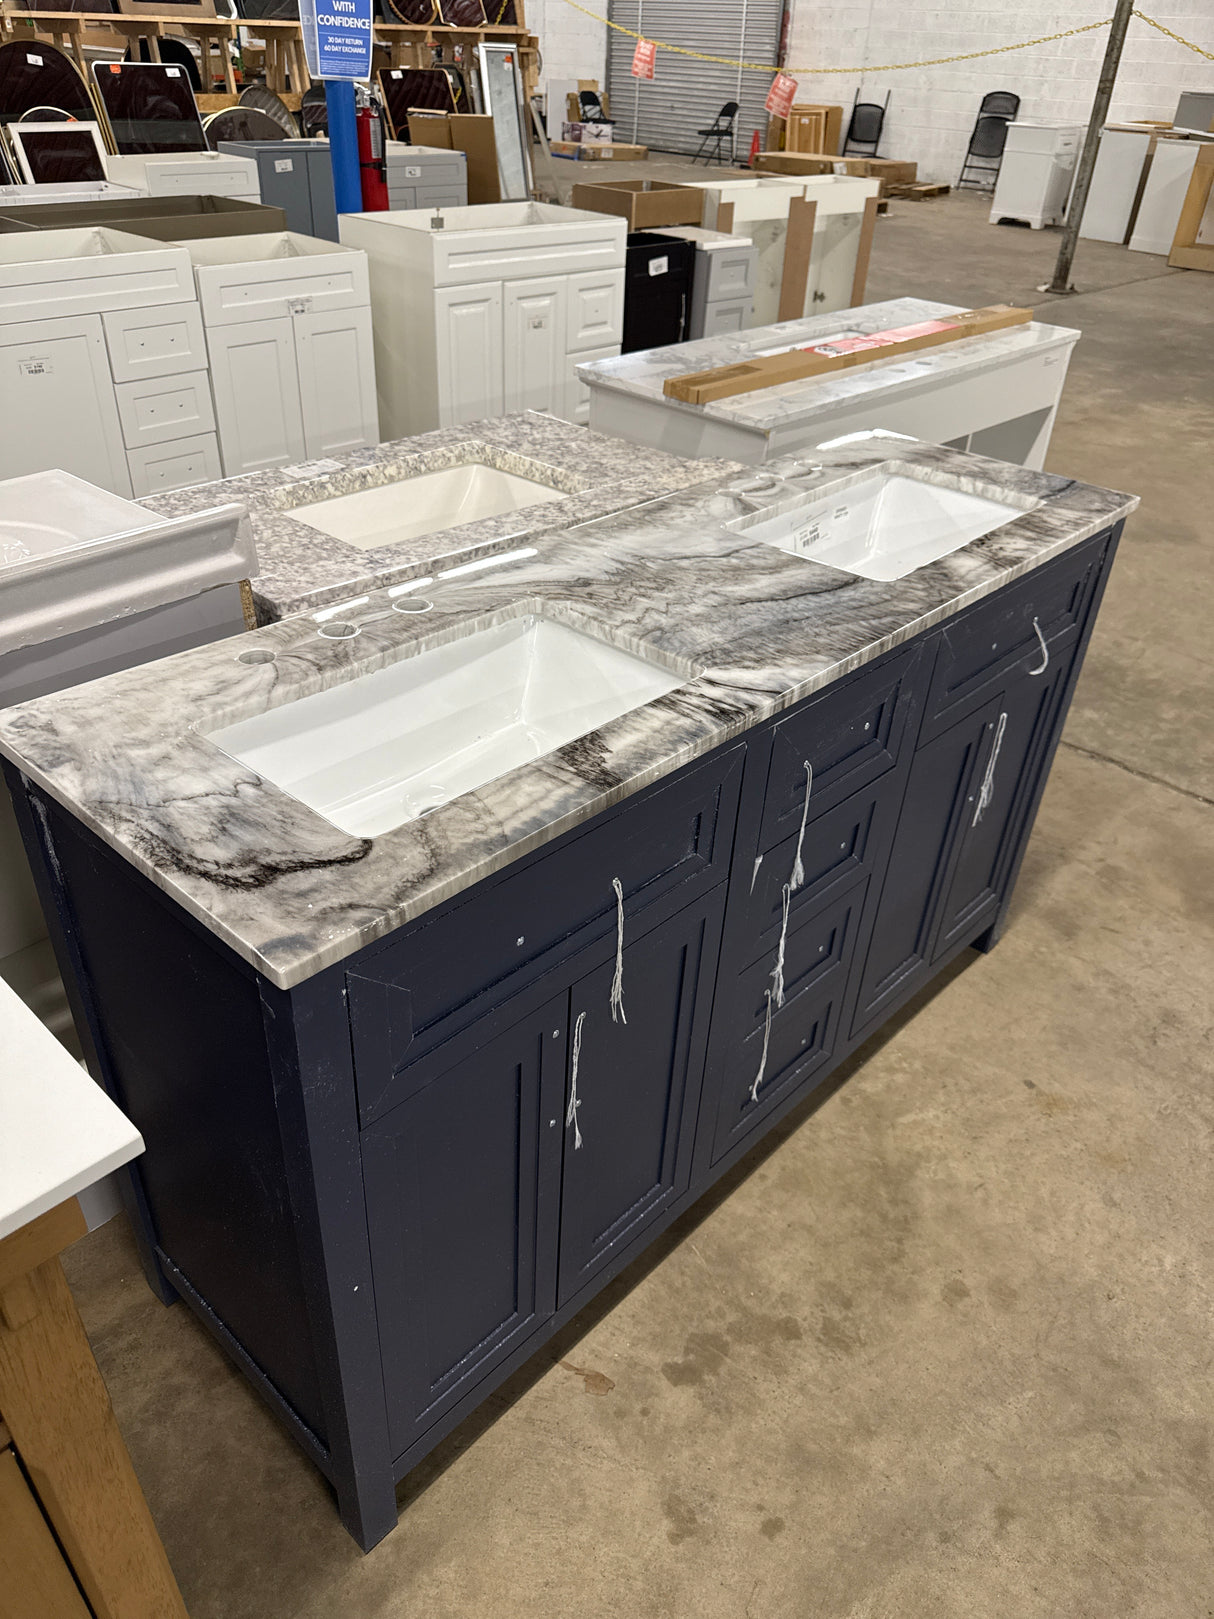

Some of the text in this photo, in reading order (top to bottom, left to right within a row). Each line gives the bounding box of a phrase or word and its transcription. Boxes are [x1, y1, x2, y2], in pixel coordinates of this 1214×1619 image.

[332, 0, 356, 13] WITH
[317, 14, 370, 29] CONFIDENCE
[345, 38, 363, 46] RETURN
[342, 46, 366, 54] EXCHANGE
